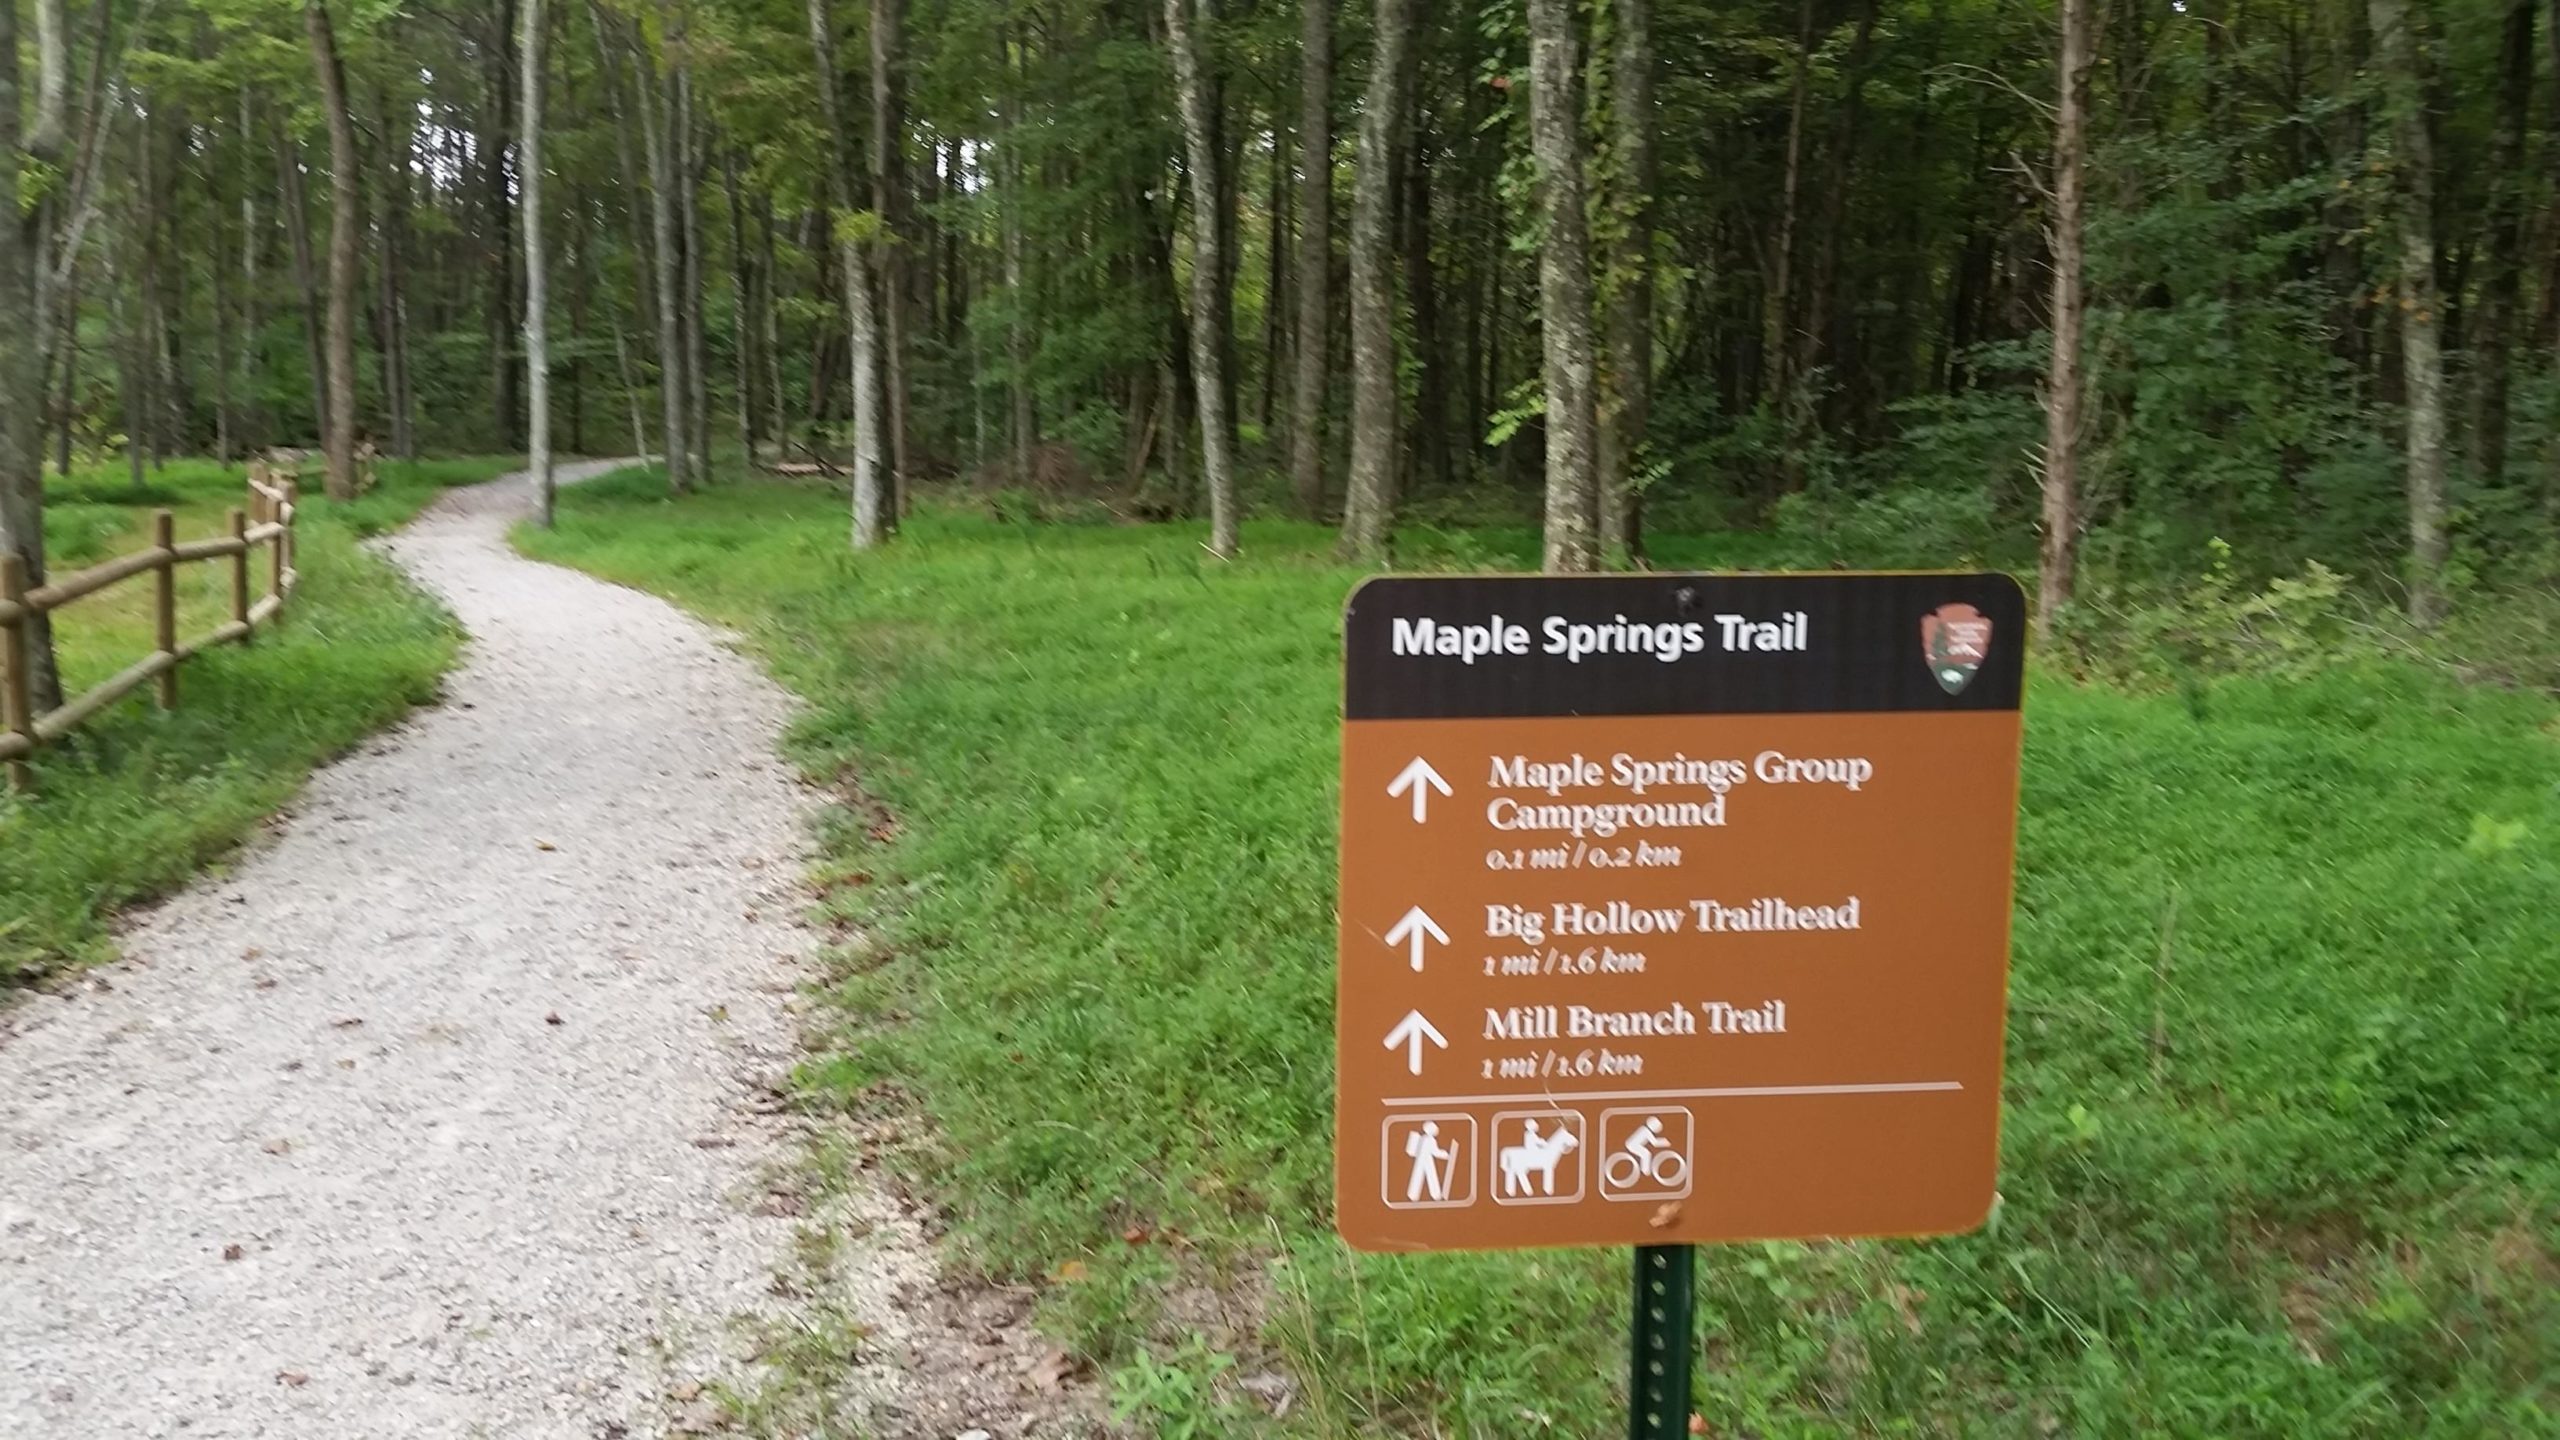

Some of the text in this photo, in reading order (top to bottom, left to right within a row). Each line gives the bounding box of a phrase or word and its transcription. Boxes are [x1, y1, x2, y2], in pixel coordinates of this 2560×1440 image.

[1393, 612, 1809, 664] Maple Springs Trail
[1487, 750, 1873, 796] Maple Springs Group
[1486, 794, 1728, 838] Campground
[1486, 850, 1524, 870] 0.1
[1635, 839, 1682, 867] km
[1484, 896, 1862, 945] Big Hollow Trailhead
[1482, 955, 1496, 976] 1
[1600, 946, 1646, 973] km
[1482, 999, 1787, 1040] Mill Branch Trail
[1481, 1059, 1494, 1079] 1
[1597, 1048, 1643, 1075] km
